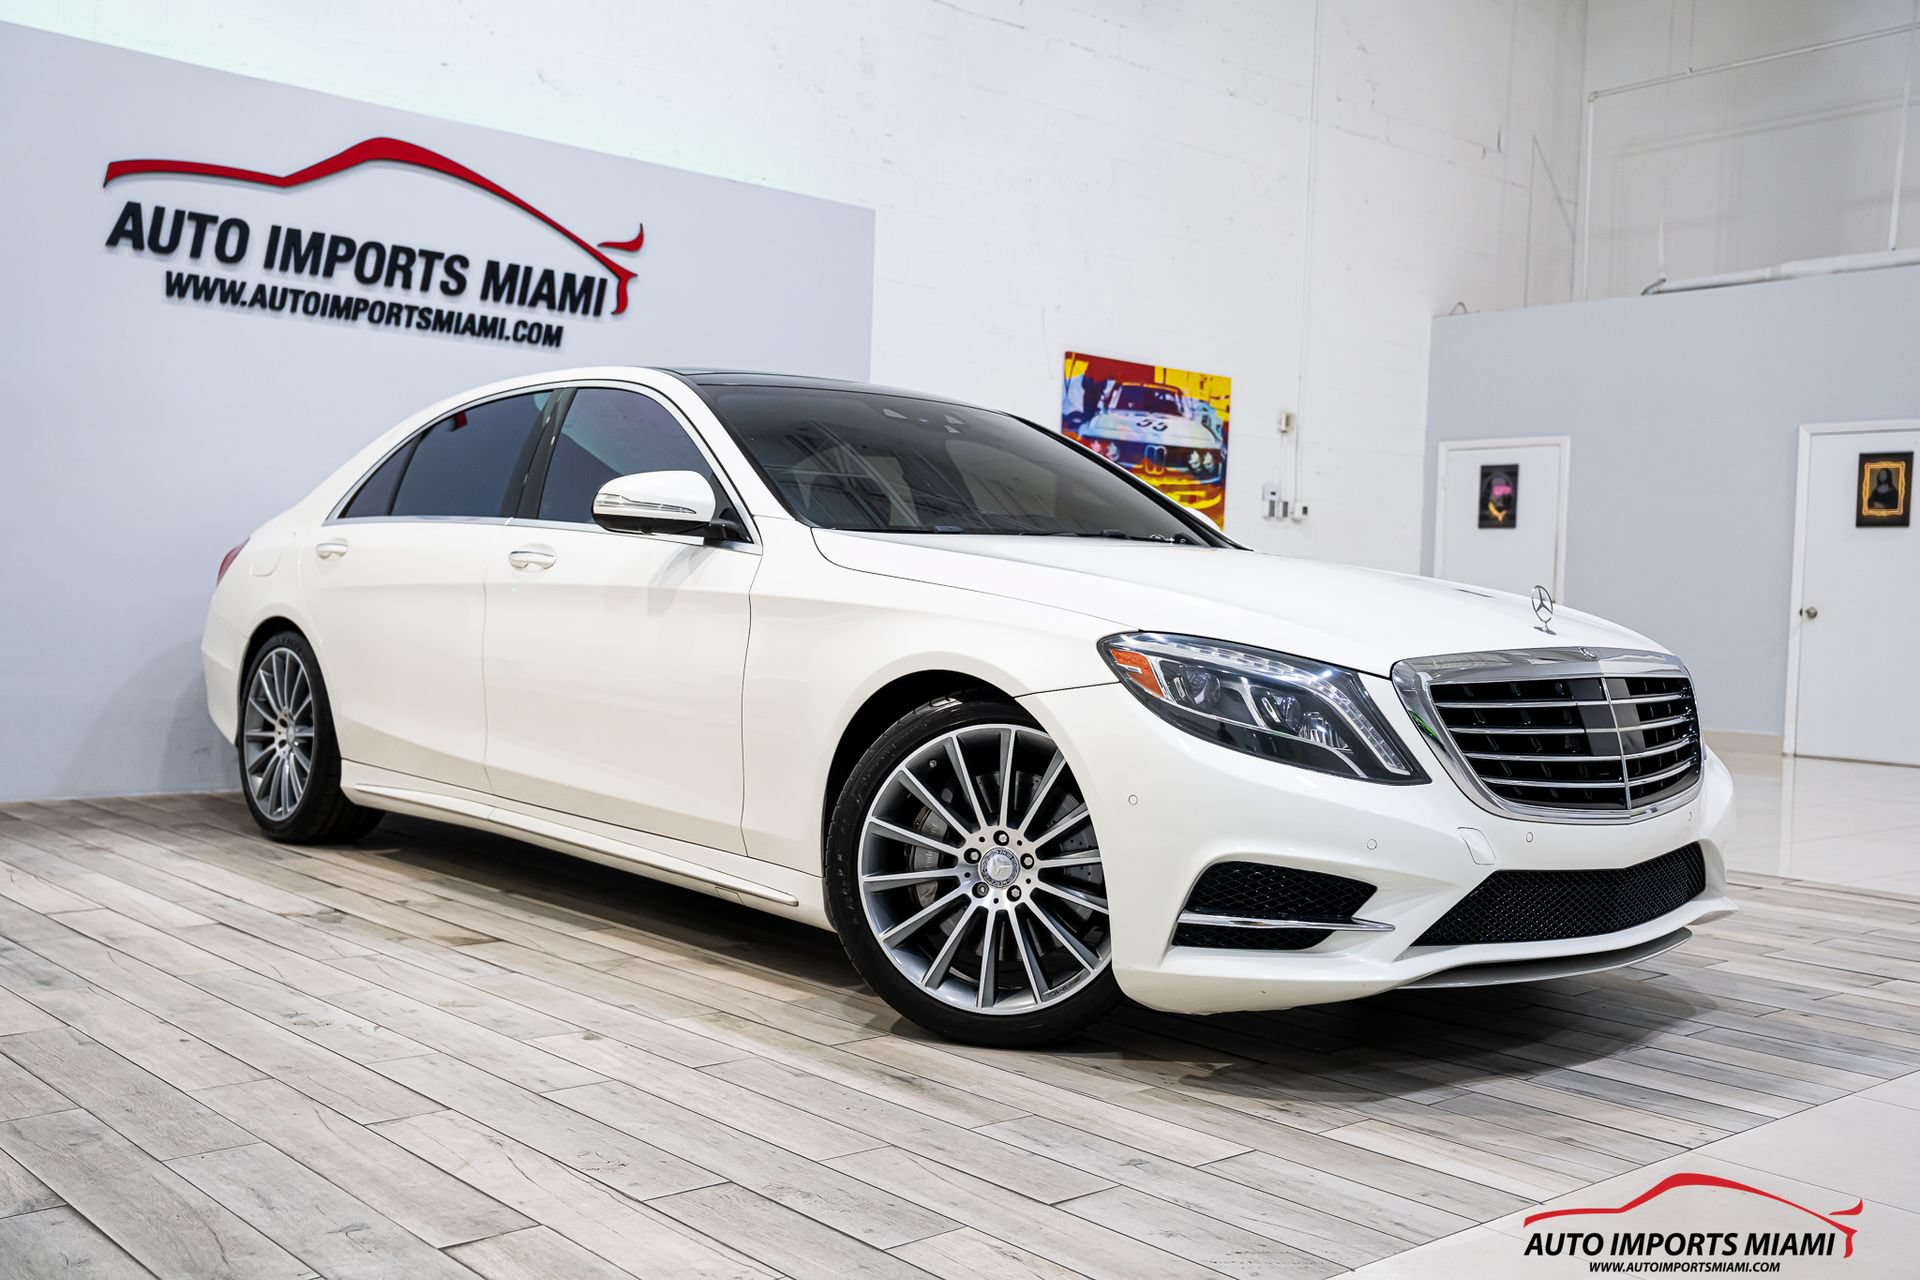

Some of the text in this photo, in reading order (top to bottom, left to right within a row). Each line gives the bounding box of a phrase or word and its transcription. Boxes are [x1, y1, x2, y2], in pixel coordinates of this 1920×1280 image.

[106, 202, 608, 317] AUTO IMPORTS MIAMI
[166, 270, 564, 348] WWW.AUTOIMPORTSMIAMI.COM
